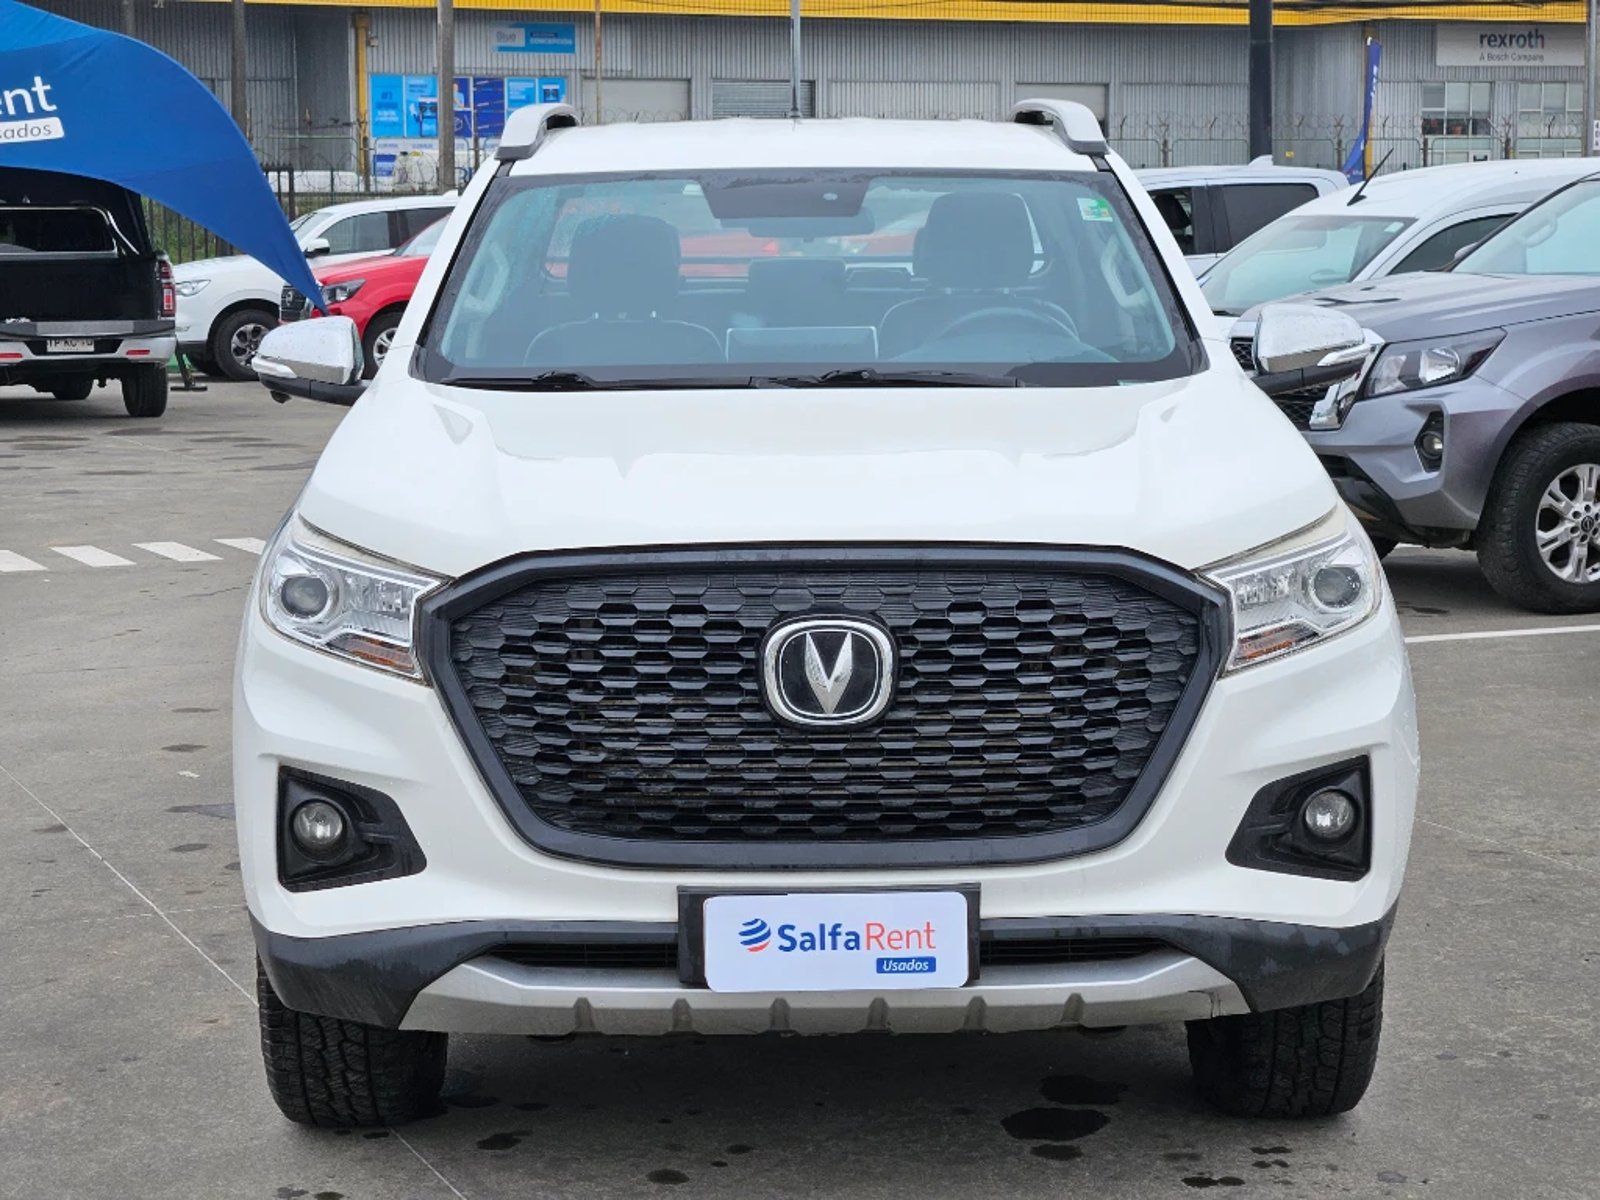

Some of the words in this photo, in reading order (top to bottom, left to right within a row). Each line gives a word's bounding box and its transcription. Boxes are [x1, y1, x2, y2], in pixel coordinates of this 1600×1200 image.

[1479, 28, 1545, 49] rexroth
[1479, 52, 1485, 61] A
[1487, 52, 1509, 61] Bosch
[1511, 52, 1544, 62] Company
[0, 76, 57, 115] nt
[0, 123, 52, 140] ados
[882, 959, 929, 972] Usados
